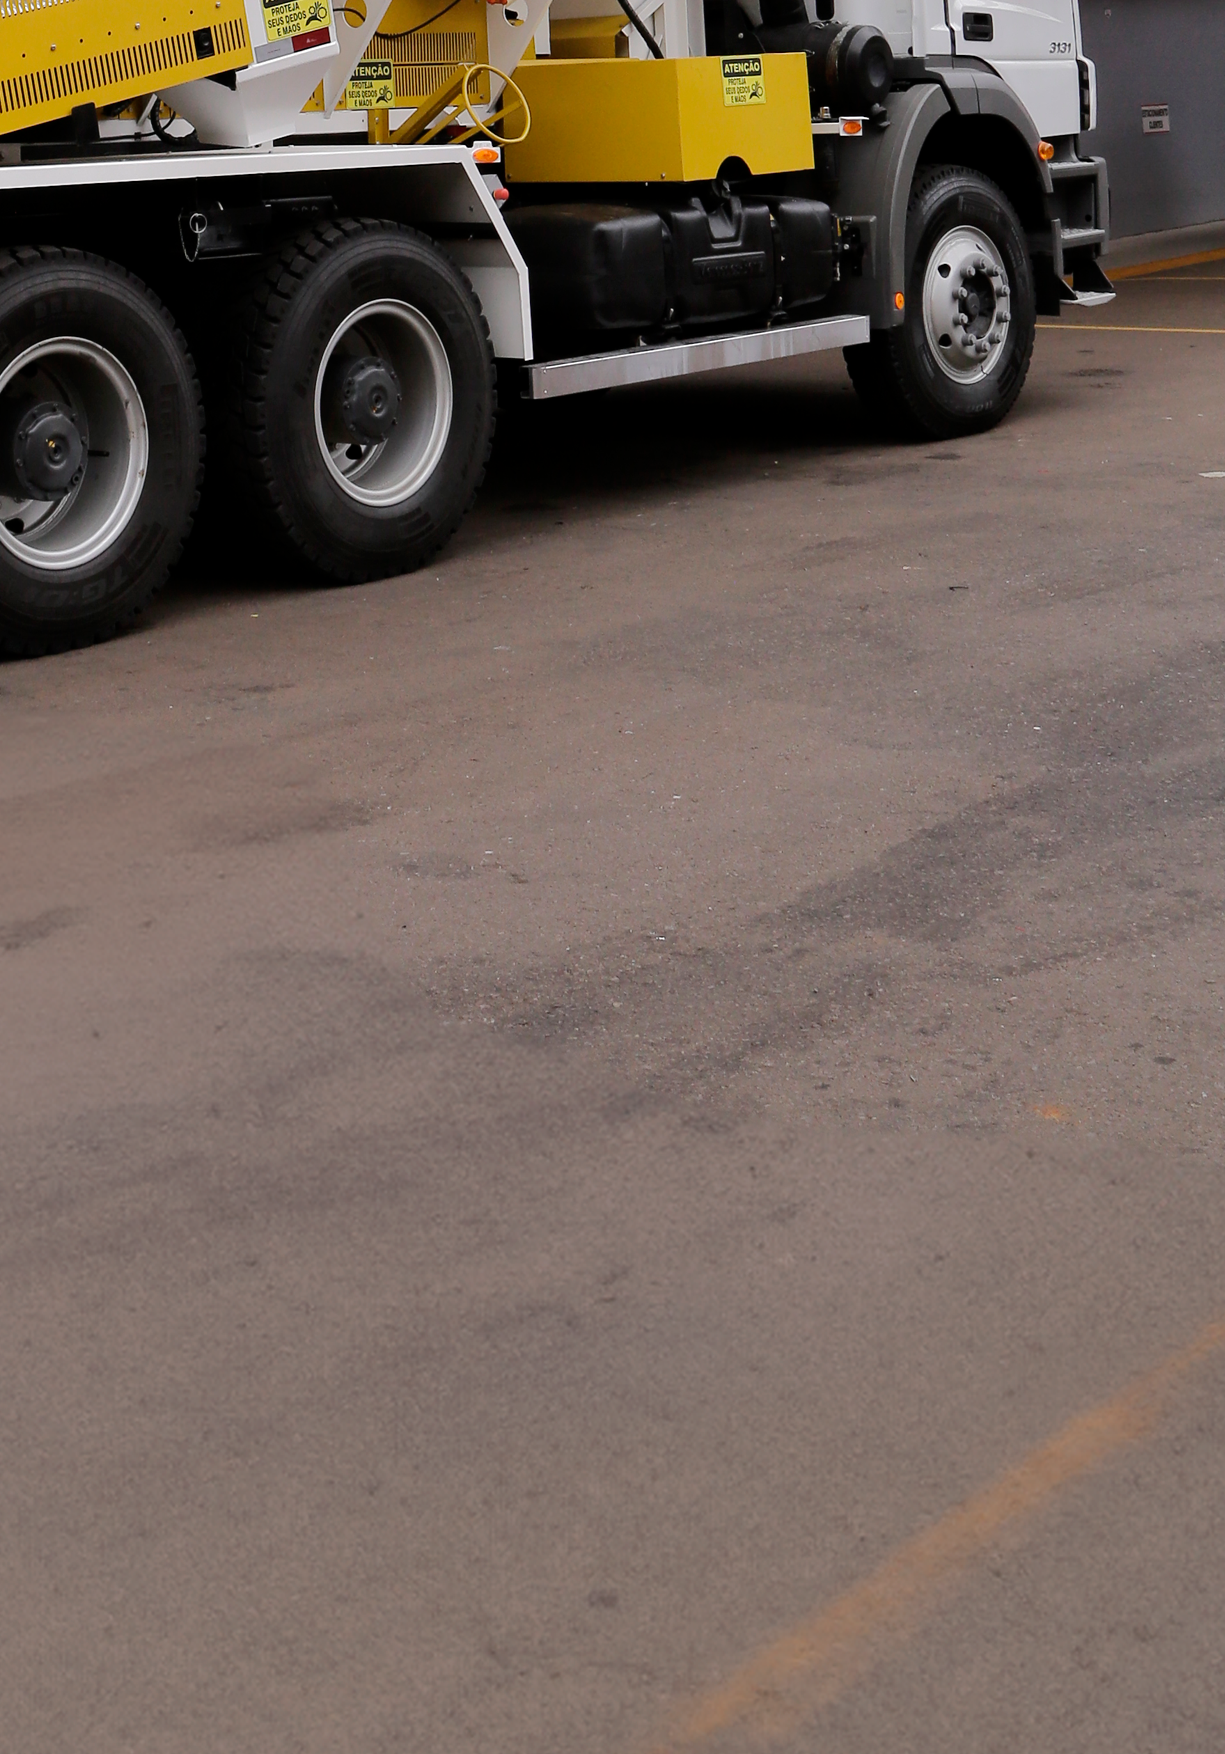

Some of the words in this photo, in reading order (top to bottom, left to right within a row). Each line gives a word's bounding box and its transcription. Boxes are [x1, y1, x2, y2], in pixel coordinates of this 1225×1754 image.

[271, 2, 300, 17] PROTEJA
[267, 15, 285, 29] SEUS
[285, 10, 307, 25] DEDOS
[276, 28, 282, 37] E
[1049, 42, 1072, 54] 3131
[725, 60, 760, 75] ATENÇÃO
